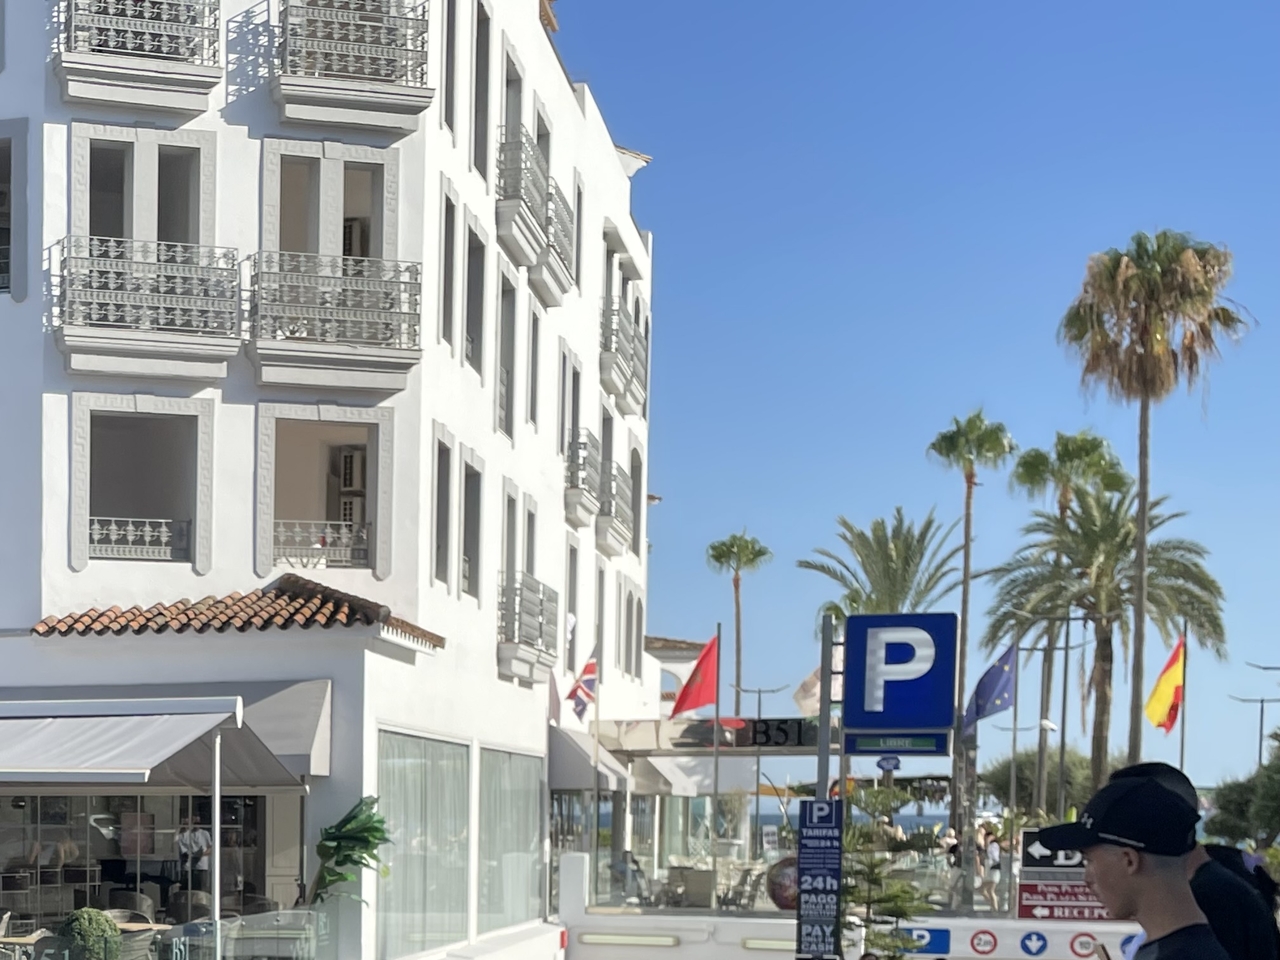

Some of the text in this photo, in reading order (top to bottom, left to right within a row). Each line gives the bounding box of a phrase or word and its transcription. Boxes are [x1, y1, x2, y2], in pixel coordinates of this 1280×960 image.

[864, 626, 936, 713] P
[751, 718, 805, 746] B51
[879, 737, 913, 748] LIBRE
[812, 802, 830, 824] P
[801, 828, 840, 838] TARIFAS
[800, 875, 838, 891] 24h
[800, 894, 837, 905] PAGO
[802, 924, 834, 936] PAY
[802, 942, 834, 953] CASH
